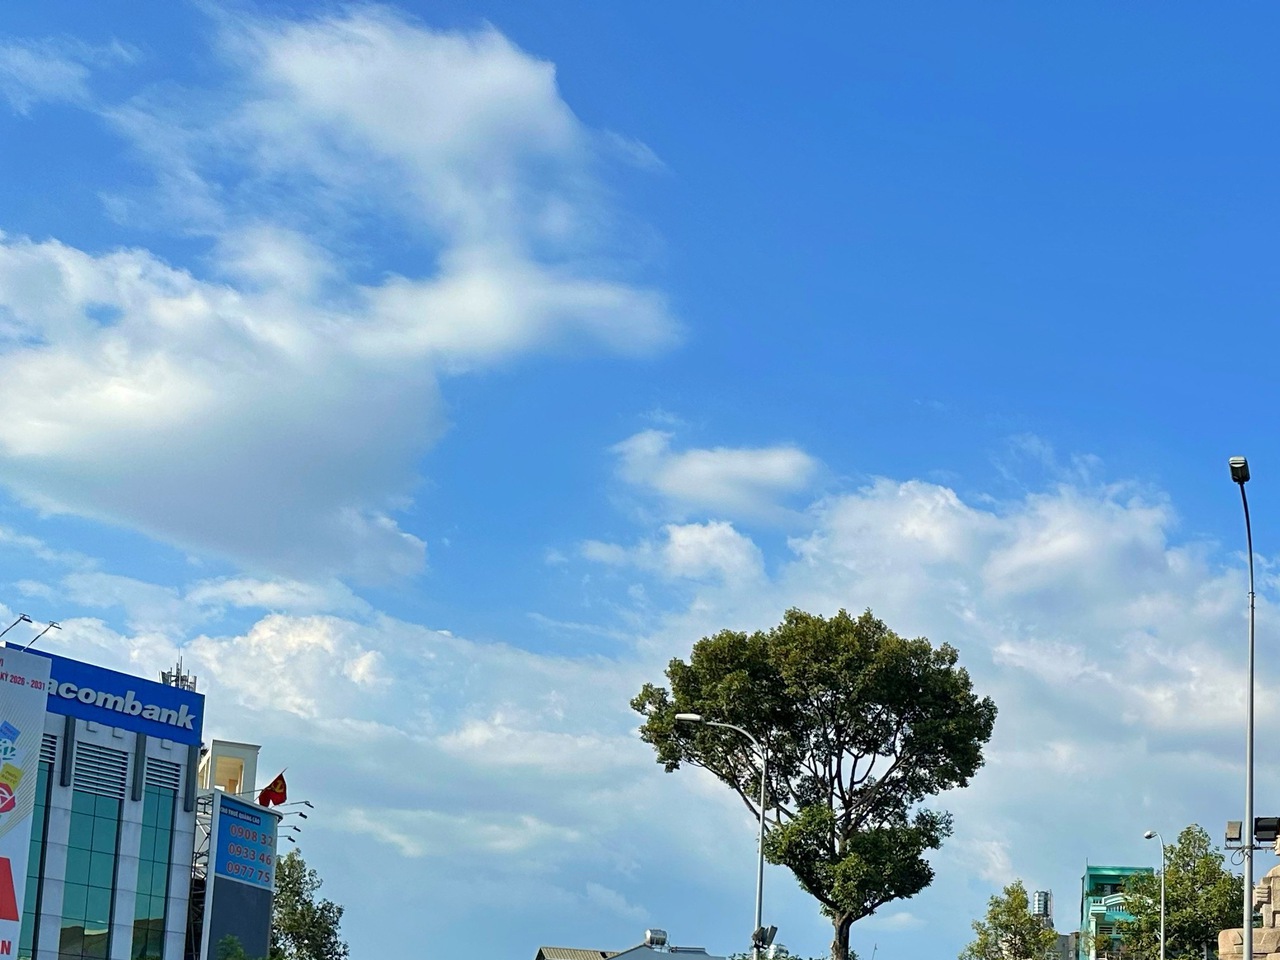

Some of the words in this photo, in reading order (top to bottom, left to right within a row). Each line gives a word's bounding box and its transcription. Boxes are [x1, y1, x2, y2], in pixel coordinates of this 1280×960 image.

[9, 673, 26, 687] 2026
[48, 678, 196, 730] acombank
[230, 823, 258, 843] 0908
[260, 833, 273, 848] 32
[228, 842, 256, 861] 0933
[259, 852, 272, 866] 46
[226, 861, 255, 879] 0977
[257, 870, 271, 883] 75
